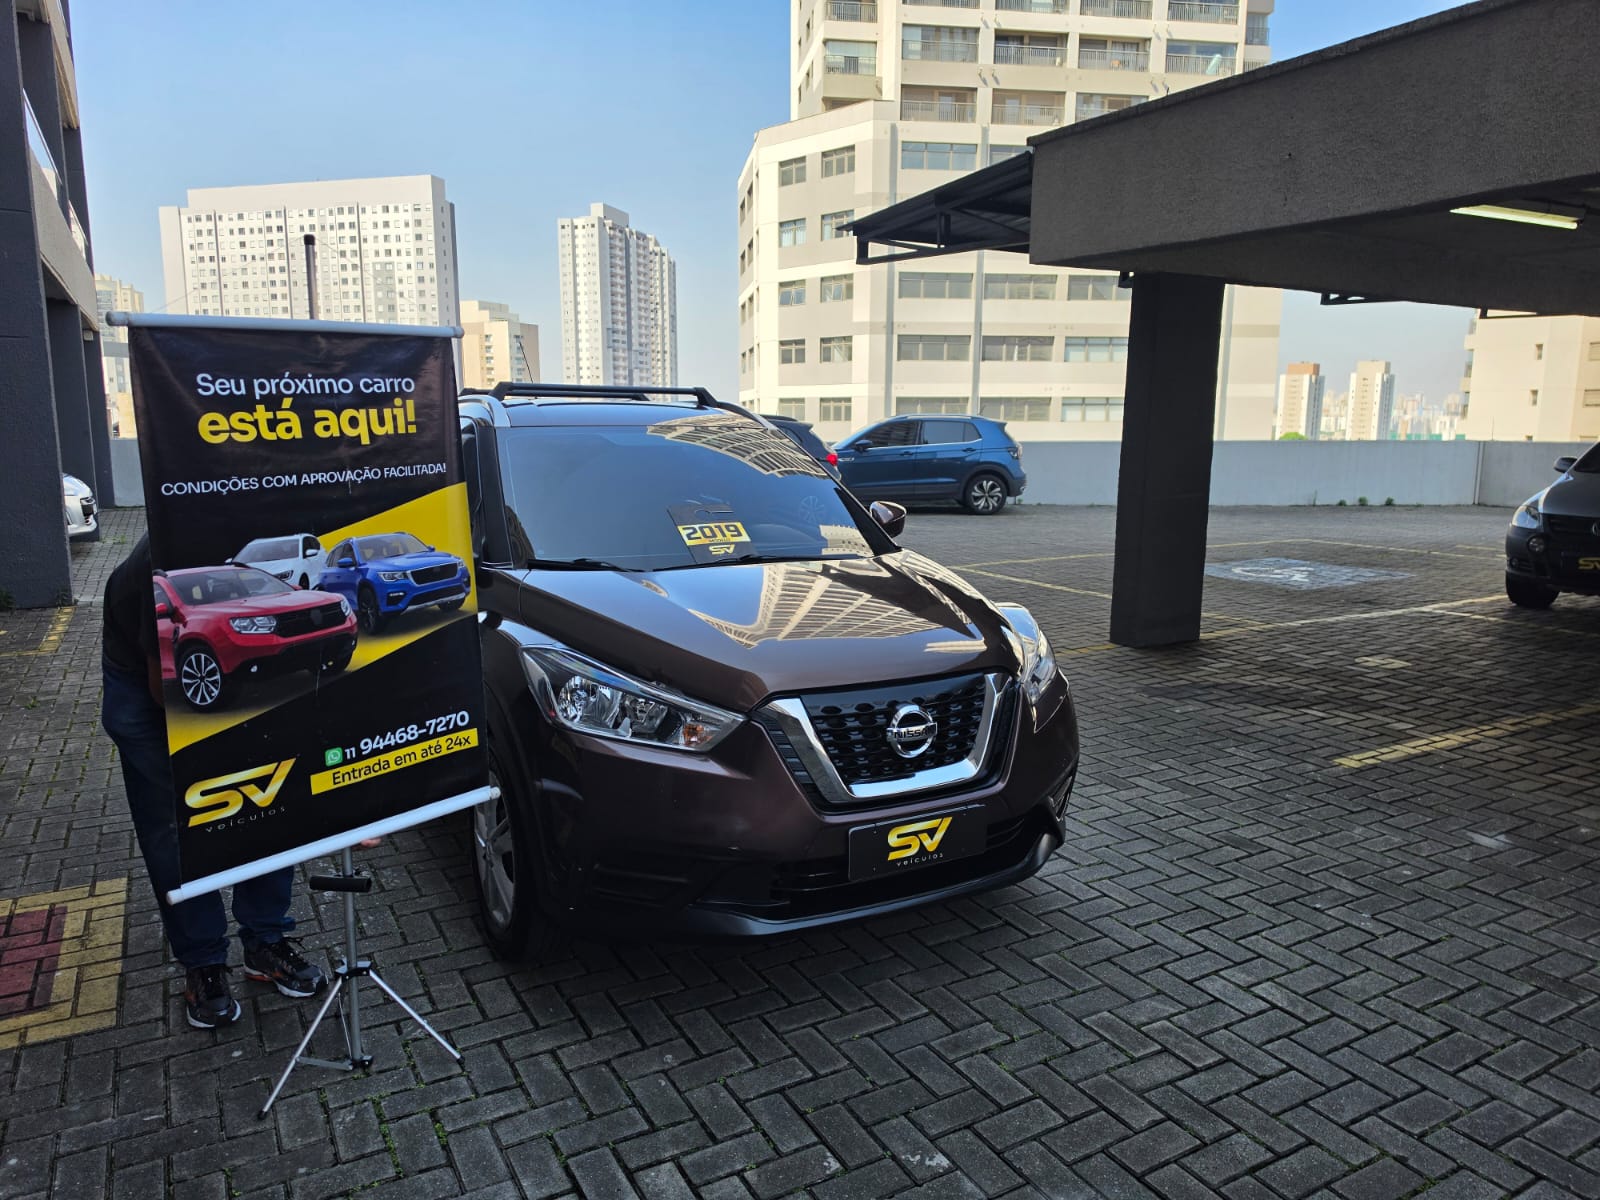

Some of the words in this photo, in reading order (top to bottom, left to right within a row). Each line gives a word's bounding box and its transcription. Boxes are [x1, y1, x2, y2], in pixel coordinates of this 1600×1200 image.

[196, 373, 246, 397] Seu
[254, 371, 354, 400] próximo
[359, 375, 415, 394] carro
[198, 398, 302, 444] está
[314, 399, 417, 445] aqui!
[161, 476, 259, 495] CONDIÇÕES
[262, 475, 297, 488] COM
[300, 466, 381, 486] APROVAÇÃO
[383, 462, 447, 479] FACILITADA!
[682, 524, 743, 540] 2019
[344, 747, 356, 760] 11
[360, 710, 470, 755] 94468-7270
[332, 759, 391, 786] Entrada
[394, 751, 417, 767] em
[421, 740, 442, 759] até
[445, 735, 471, 751] 24x
[184, 757, 297, 828] SV
[887, 816, 953, 861] SV
